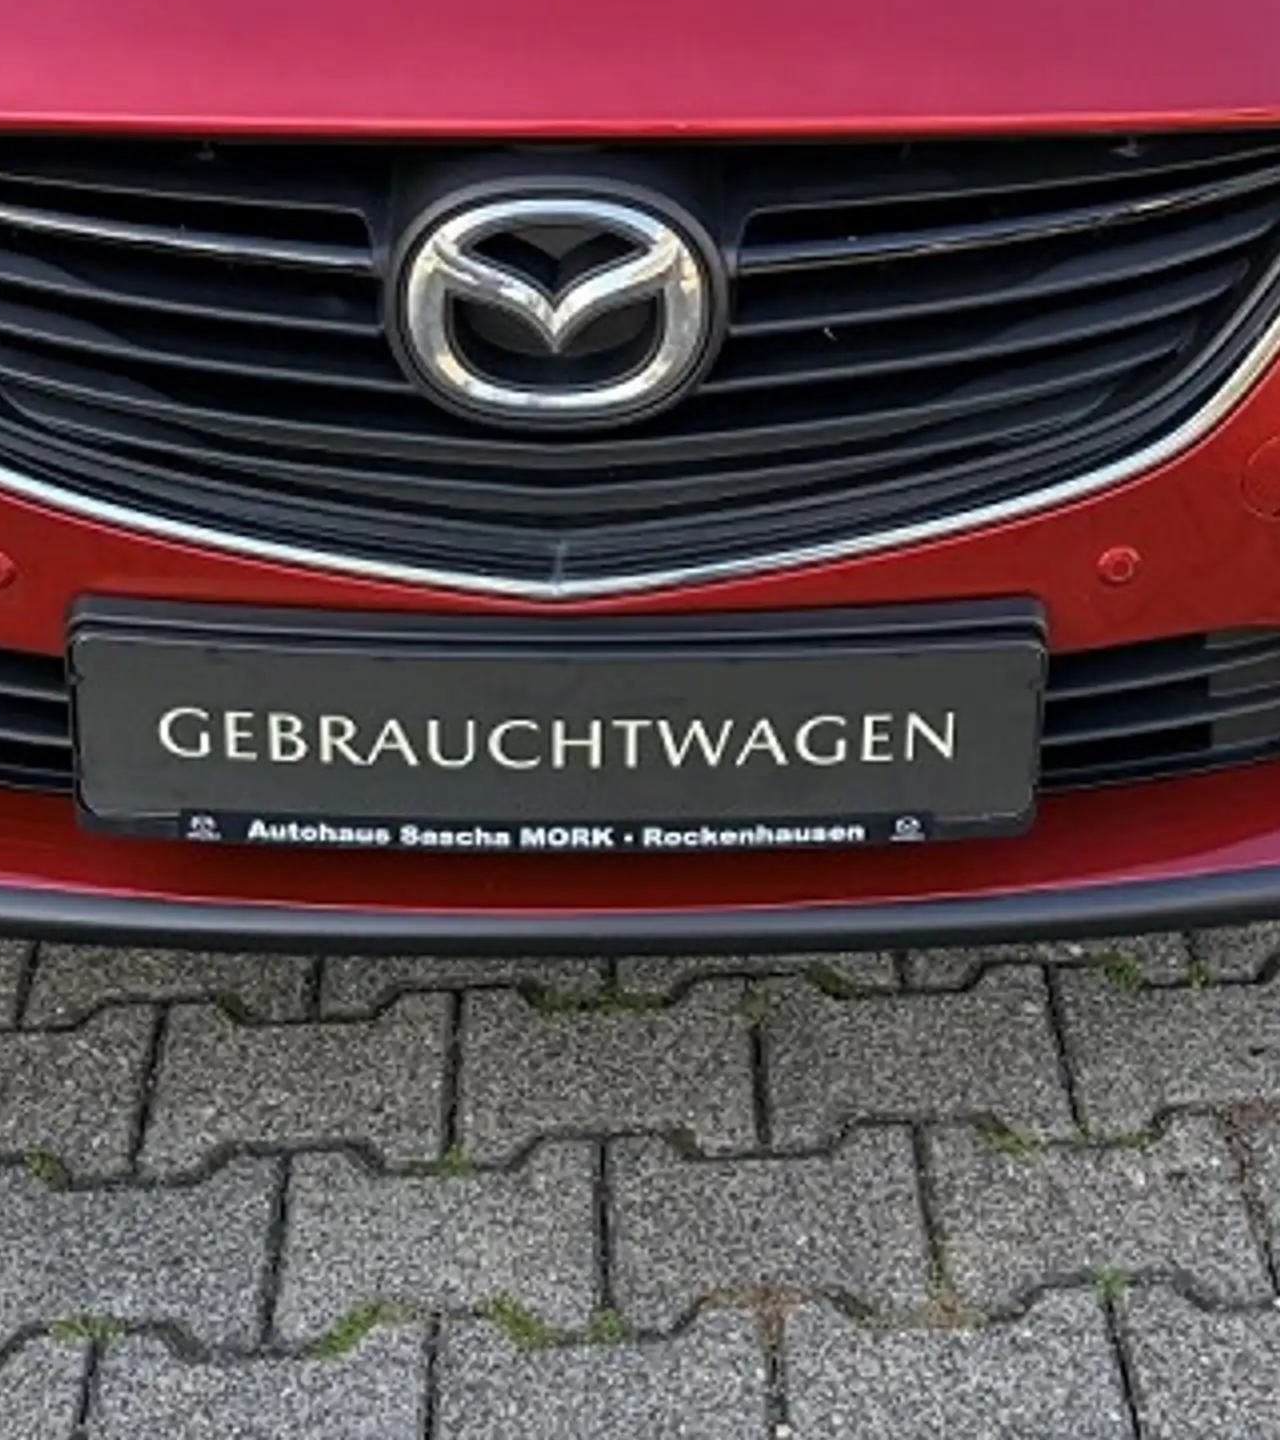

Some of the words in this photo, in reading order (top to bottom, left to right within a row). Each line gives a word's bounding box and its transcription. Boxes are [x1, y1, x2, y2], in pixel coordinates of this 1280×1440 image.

[157, 706, 955, 769] GEBRAUCHTWAGEN
[247, 819, 391, 845] Autohaus
[400, 824, 511, 847] Sascha
[520, 827, 615, 848] MORK
[643, 822, 867, 848] Rockenhausen
